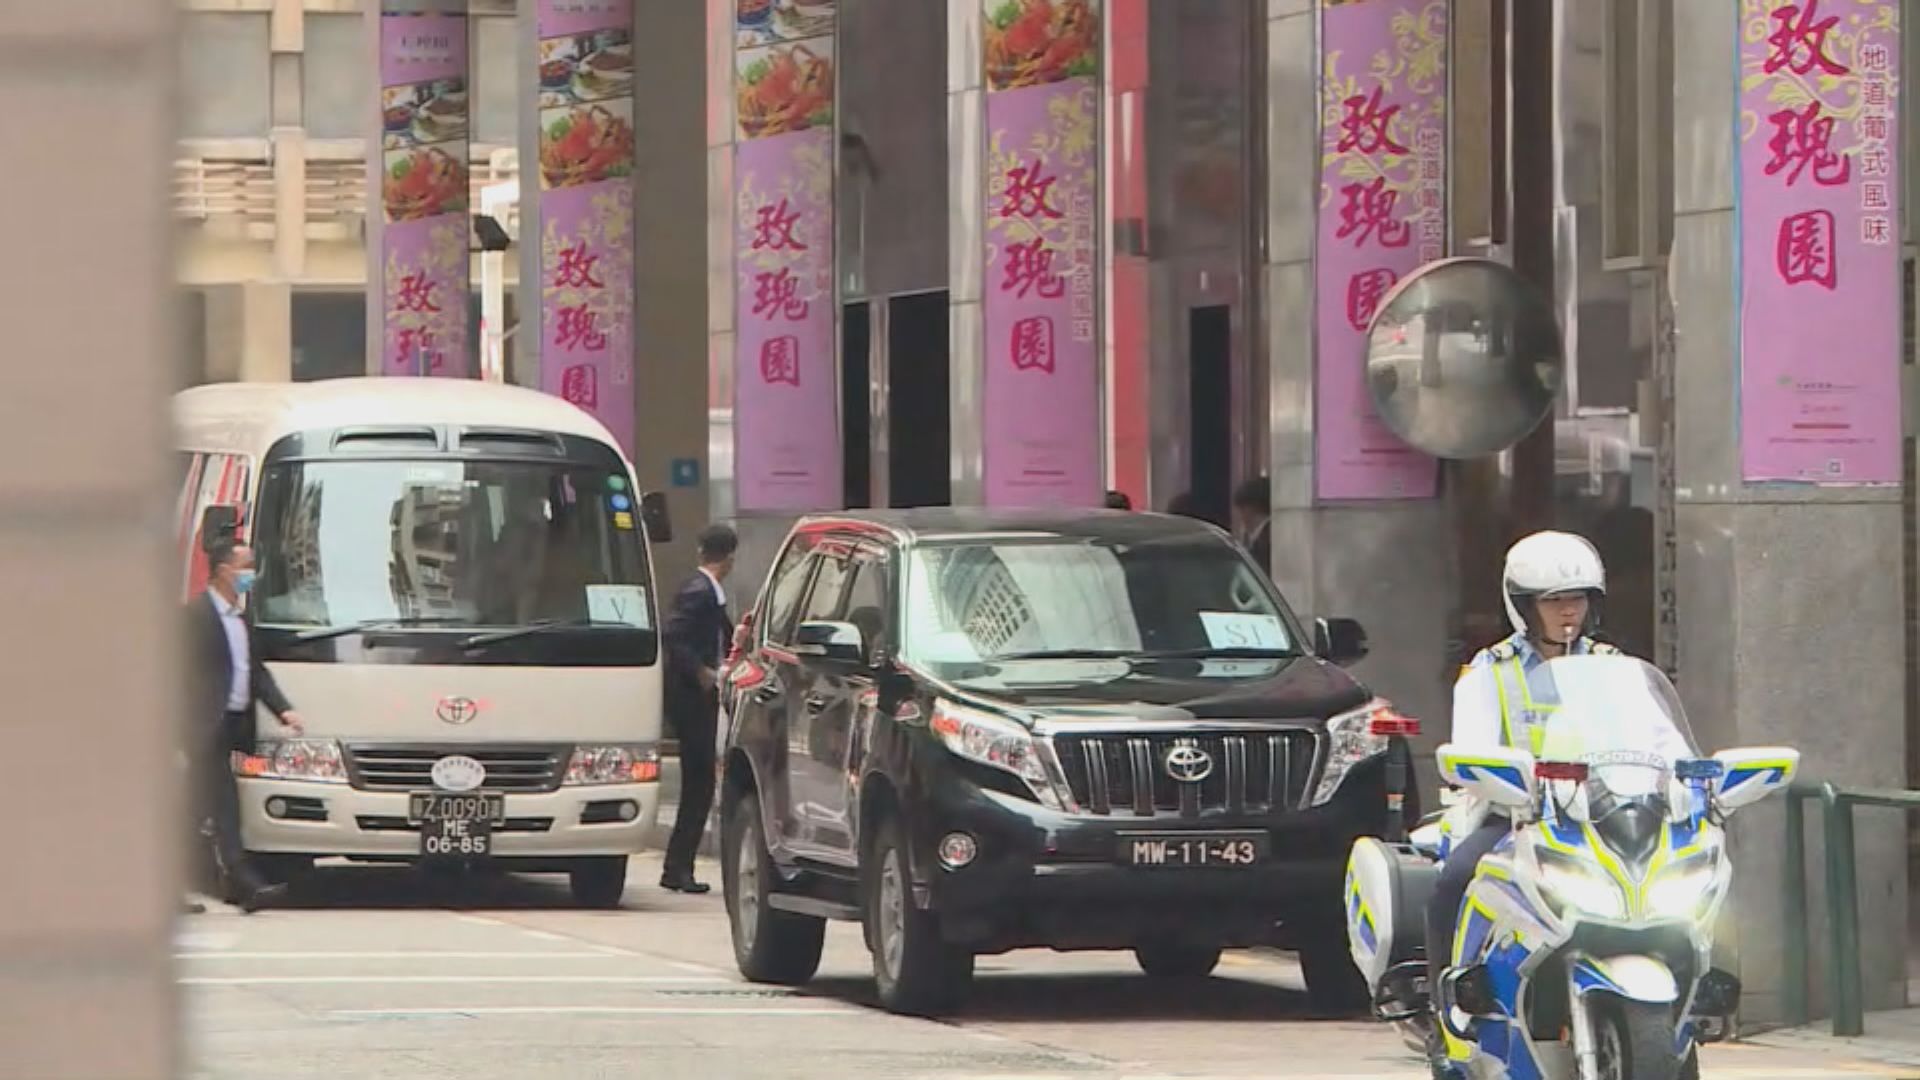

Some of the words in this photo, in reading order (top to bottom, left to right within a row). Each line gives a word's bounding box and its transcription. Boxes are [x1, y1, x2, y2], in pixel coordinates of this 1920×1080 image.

[1763, 0, 1850, 290] 玫瑰園
[1863, 47, 1888, 242] 地道葡式風味
[554, 240, 606, 410] 玫瑰園
[752, 197, 808, 387] 玫瑰園
[1001, 158, 1065, 374] 玫瑰園
[426, 836, 486, 854] 06-85
[443, 819, 470, 837] ME
[1133, 841, 1255, 864] MW-11-43
